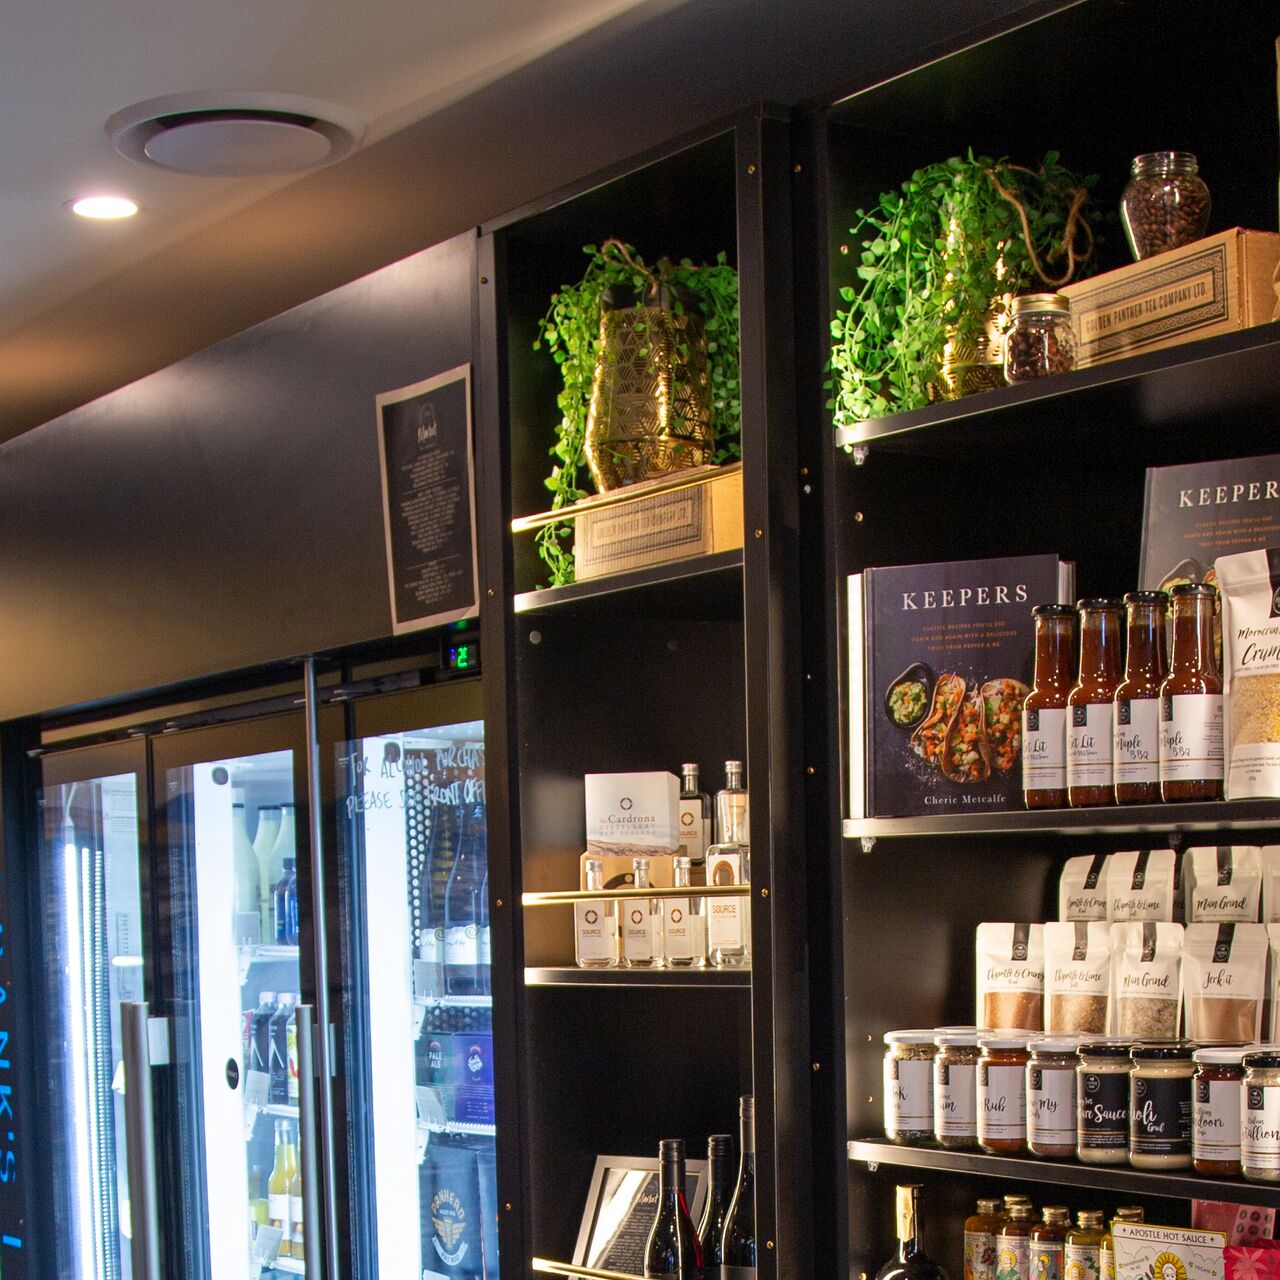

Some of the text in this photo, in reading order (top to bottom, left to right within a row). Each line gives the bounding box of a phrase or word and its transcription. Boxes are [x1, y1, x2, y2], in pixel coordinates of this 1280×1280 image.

[1114, 304, 1143, 328] PANTHER
[1145, 296, 1157, 314] TEA
[1159, 289, 1191, 311] COMPANY
[902, 584, 1028, 611] KEEPERS
[346, 789, 392, 819] PLEASE
[924, 793, 1006, 805] Cherie Metcalfe
[608, 814, 655, 823] Cardrona
[712, 904, 737, 914] SOURCE
[1093, 1104, 1127, 1123] Sauce
[1130, 1229, 1207, 1244] APOSTLE HOT SAUCE
